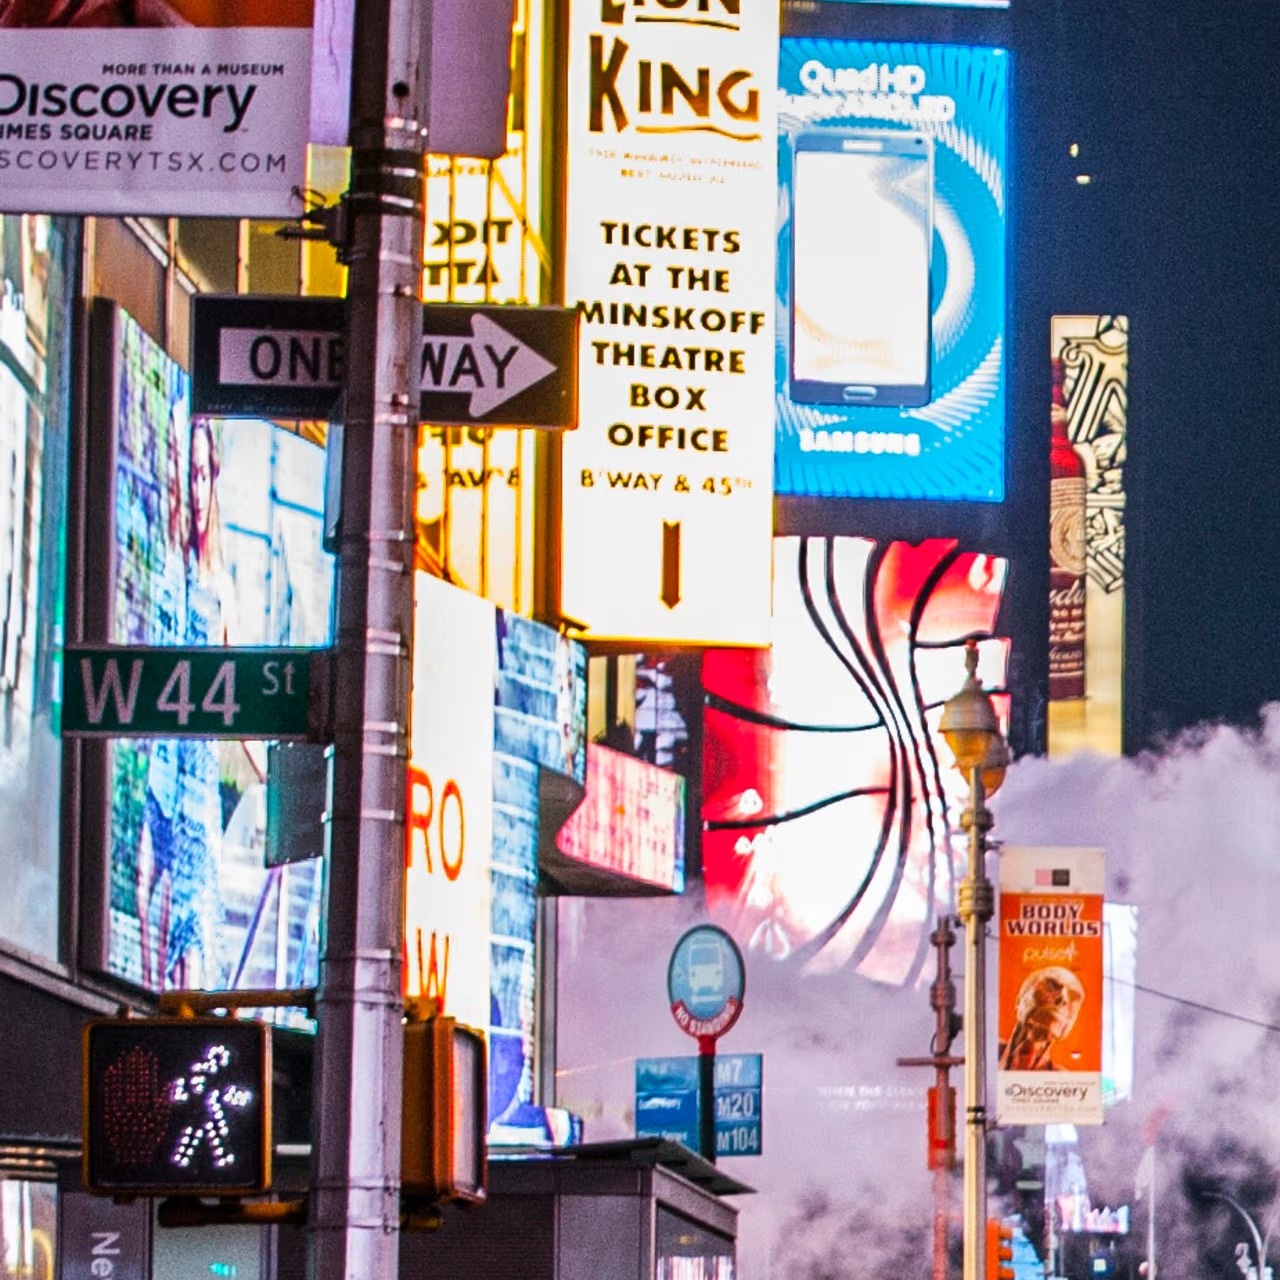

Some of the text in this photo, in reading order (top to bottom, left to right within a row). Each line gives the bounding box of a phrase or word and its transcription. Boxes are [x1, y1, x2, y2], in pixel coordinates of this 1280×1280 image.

[102, 63, 285, 76] MORE THAN A MUSEUM
[588, 33, 760, 134] KING
[0, 123, 152, 141] IMES SQUARE
[0, 151, 286, 173] SCOVERYTSX.COM
[600, 221, 741, 254] TICKETS
[608, 262, 730, 293] AT THE
[577, 300, 766, 336] MINSKOFF
[249, 335, 519, 389] ONE WAY
[591, 341, 746, 375] THEATRE
[630, 383, 707, 412] BOX
[608, 422, 729, 453] OFFICE
[674, 474, 691, 494] &
[80, 657, 295, 727] W 44 St
[1021, 903, 1084, 921] BODY
[1006, 920, 1101, 937] WORLDS
[717, 1058, 744, 1084] M7
[1013, 1083, 1088, 1101] Discovery
[717, 1093, 755, 1119] M20
[717, 1125, 759, 1150] M104
